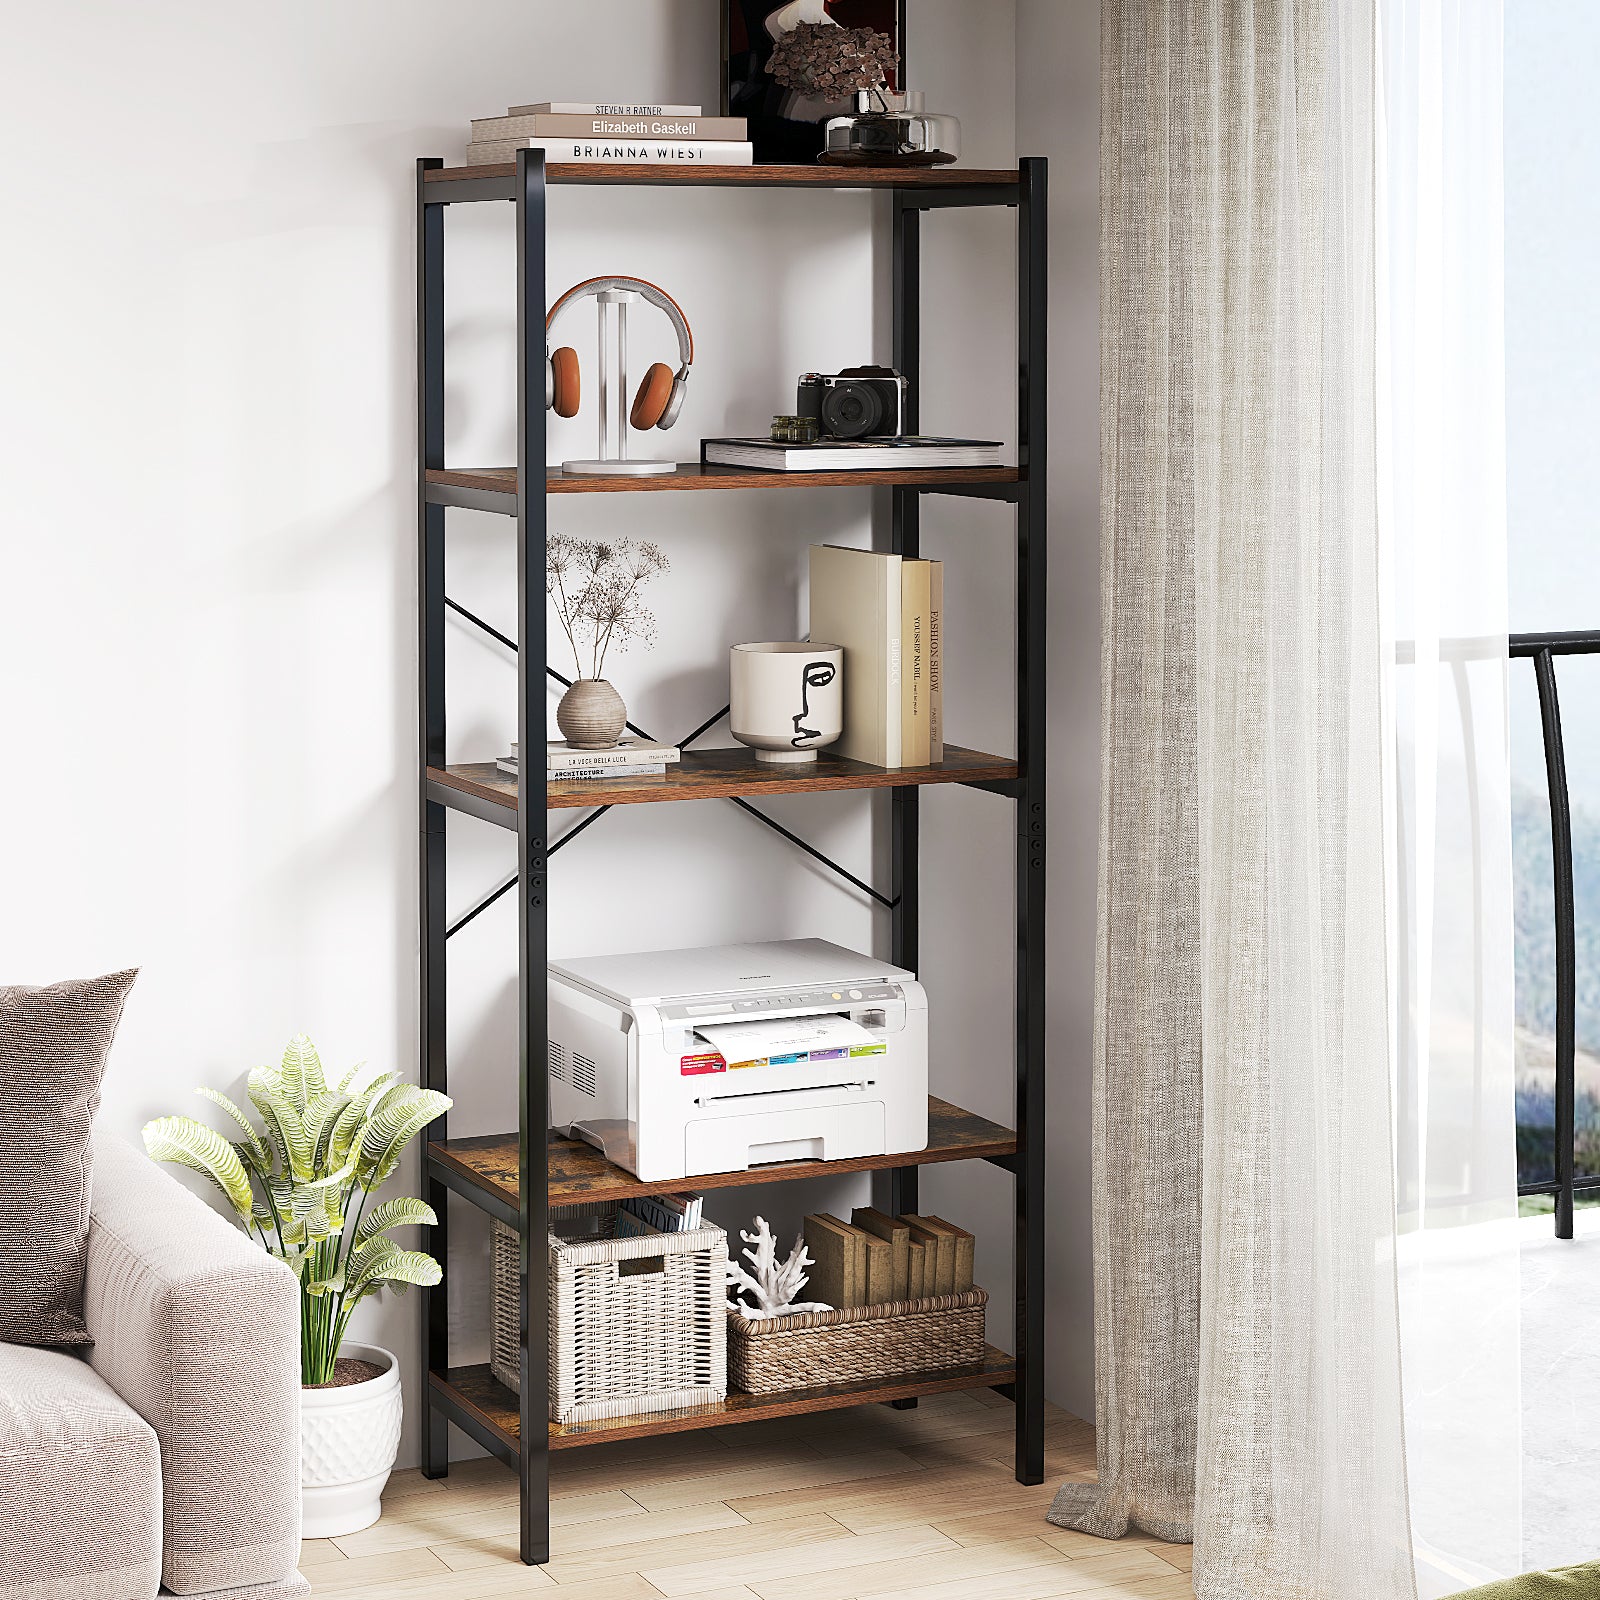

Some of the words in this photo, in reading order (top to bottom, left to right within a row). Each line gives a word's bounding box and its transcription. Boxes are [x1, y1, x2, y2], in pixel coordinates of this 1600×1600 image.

[595, 105, 624, 115] STEVEN
[633, 106, 662, 116] RATNER
[592, 120, 648, 134] Elizabeth
[651, 121, 696, 135] Gaskell
[573, 145, 648, 158] BRIANNA
[657, 147, 704, 159] WIEST
[930, 611, 939, 657] FASHION
[930, 660, 939, 692] SHOW
[554, 769, 604, 777] ARCHITECTURE
